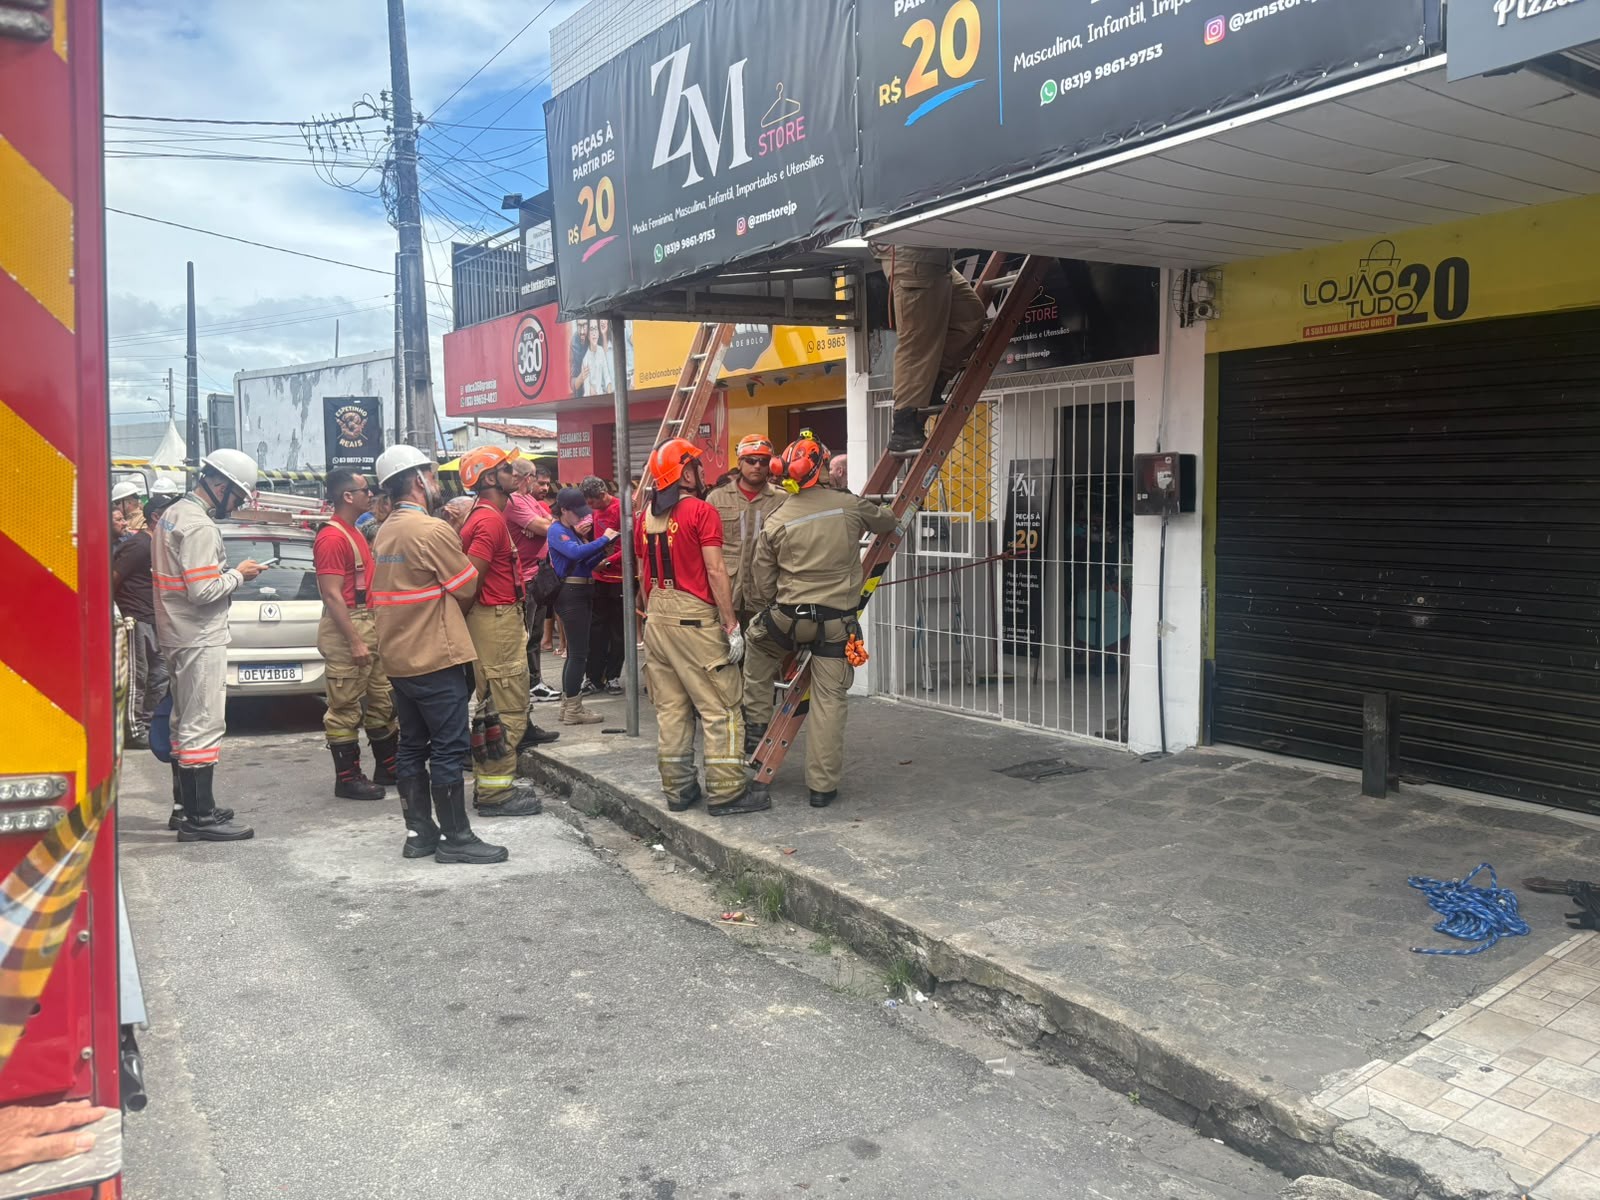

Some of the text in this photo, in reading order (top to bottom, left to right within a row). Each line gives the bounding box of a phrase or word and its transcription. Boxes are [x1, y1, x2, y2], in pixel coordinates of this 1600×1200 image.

[1013, 35, 1083, 73] Masculina,
[1087, 1, 1147, 43] Infantil,
[879, 0, 981, 107] R$ 20
[1060, 43, 1164, 95] (83)9 9861-9753
[651, 42, 753, 188] ZM
[571, 120, 614, 160] PEÇAS À
[758, 116, 806, 157] STORE
[572, 147, 615, 181] PARTIR DE:
[567, 175, 615, 245] R$ 20
[632, 223, 648, 236] Moda
[736, 172, 778, 198] Importados
[779, 170, 785, 180] e
[786, 154, 825, 177] Utensílios
[747, 200, 798, 229] @zmstorejp
[681, 228, 716, 249] 9861-9753
[1304, 269, 1394, 306] LOJÃO
[1397, 256, 1470, 326] 20
[1024, 306, 1058, 323] STORE
[1346, 293, 1414, 319] TUDO
[816, 340, 826, 351] 83
[335, 405, 368, 417] ESPETINHO
[339, 438, 363, 448] REAIS
[560, 447, 573, 459] EXAME
[573, 447, 578, 457] DE
[1011, 473, 1036, 497] ZM
[1016, 529, 1038, 549] 20
[244, 668, 296, 680] OEV1B08
